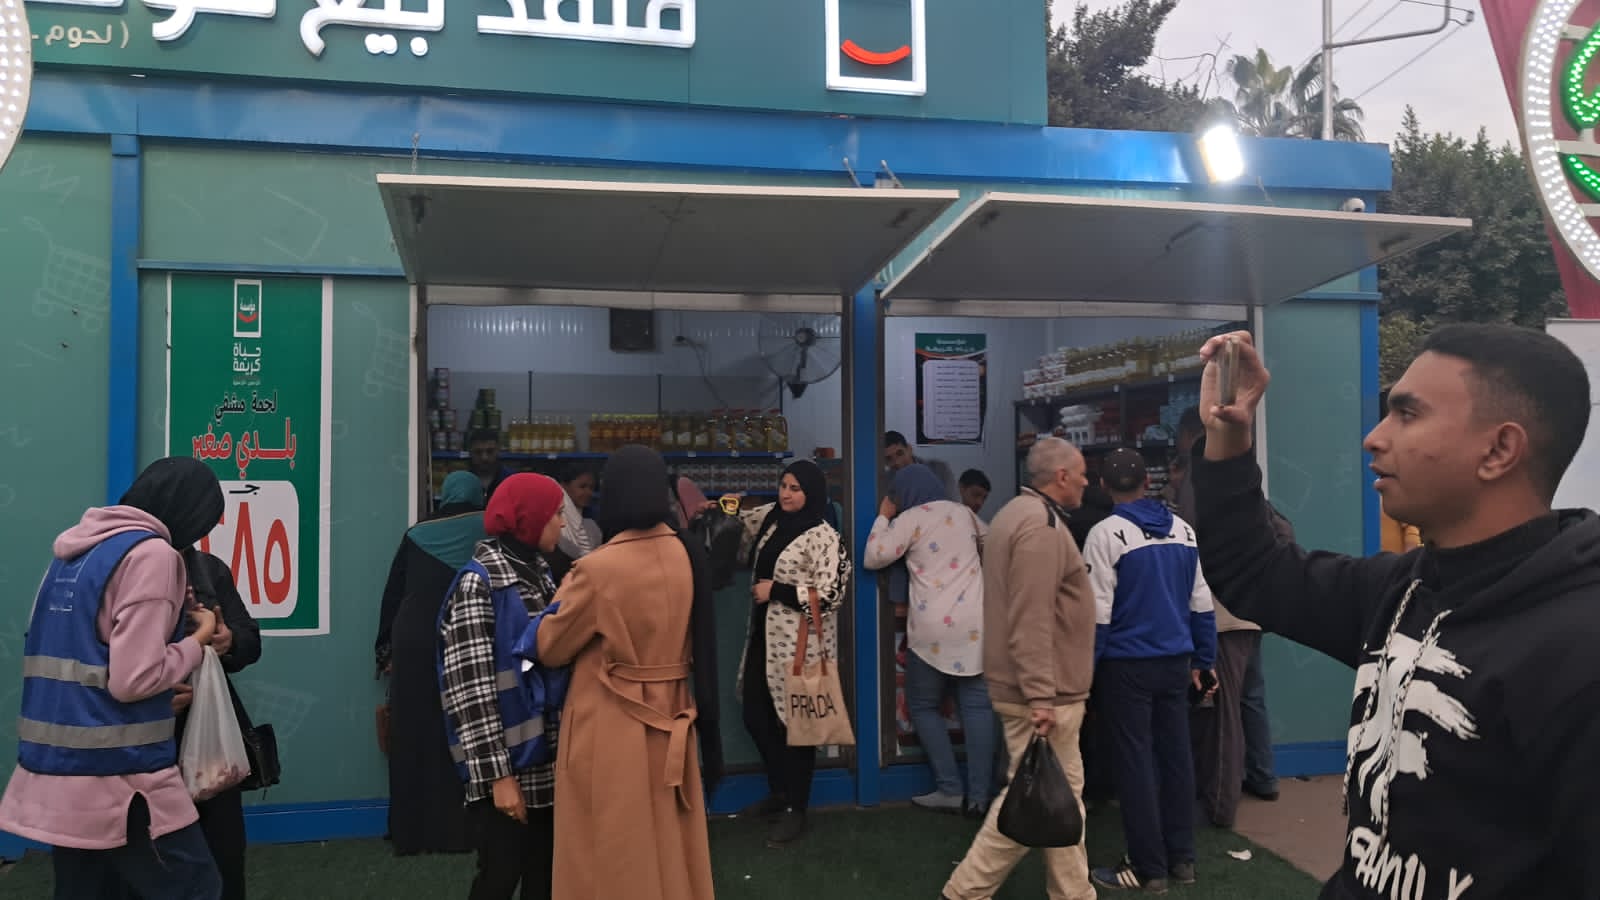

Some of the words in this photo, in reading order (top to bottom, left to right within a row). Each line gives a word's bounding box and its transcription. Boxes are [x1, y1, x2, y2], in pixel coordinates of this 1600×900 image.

[233, 342, 262, 357] حياة
[233, 358, 262, 376] كريمة
[252, 390, 278, 413] لحمة
[236, 416, 297, 480] بلدي
[200, 501, 292, 605] ٨٥
[790, 694, 838, 720] PRADA
